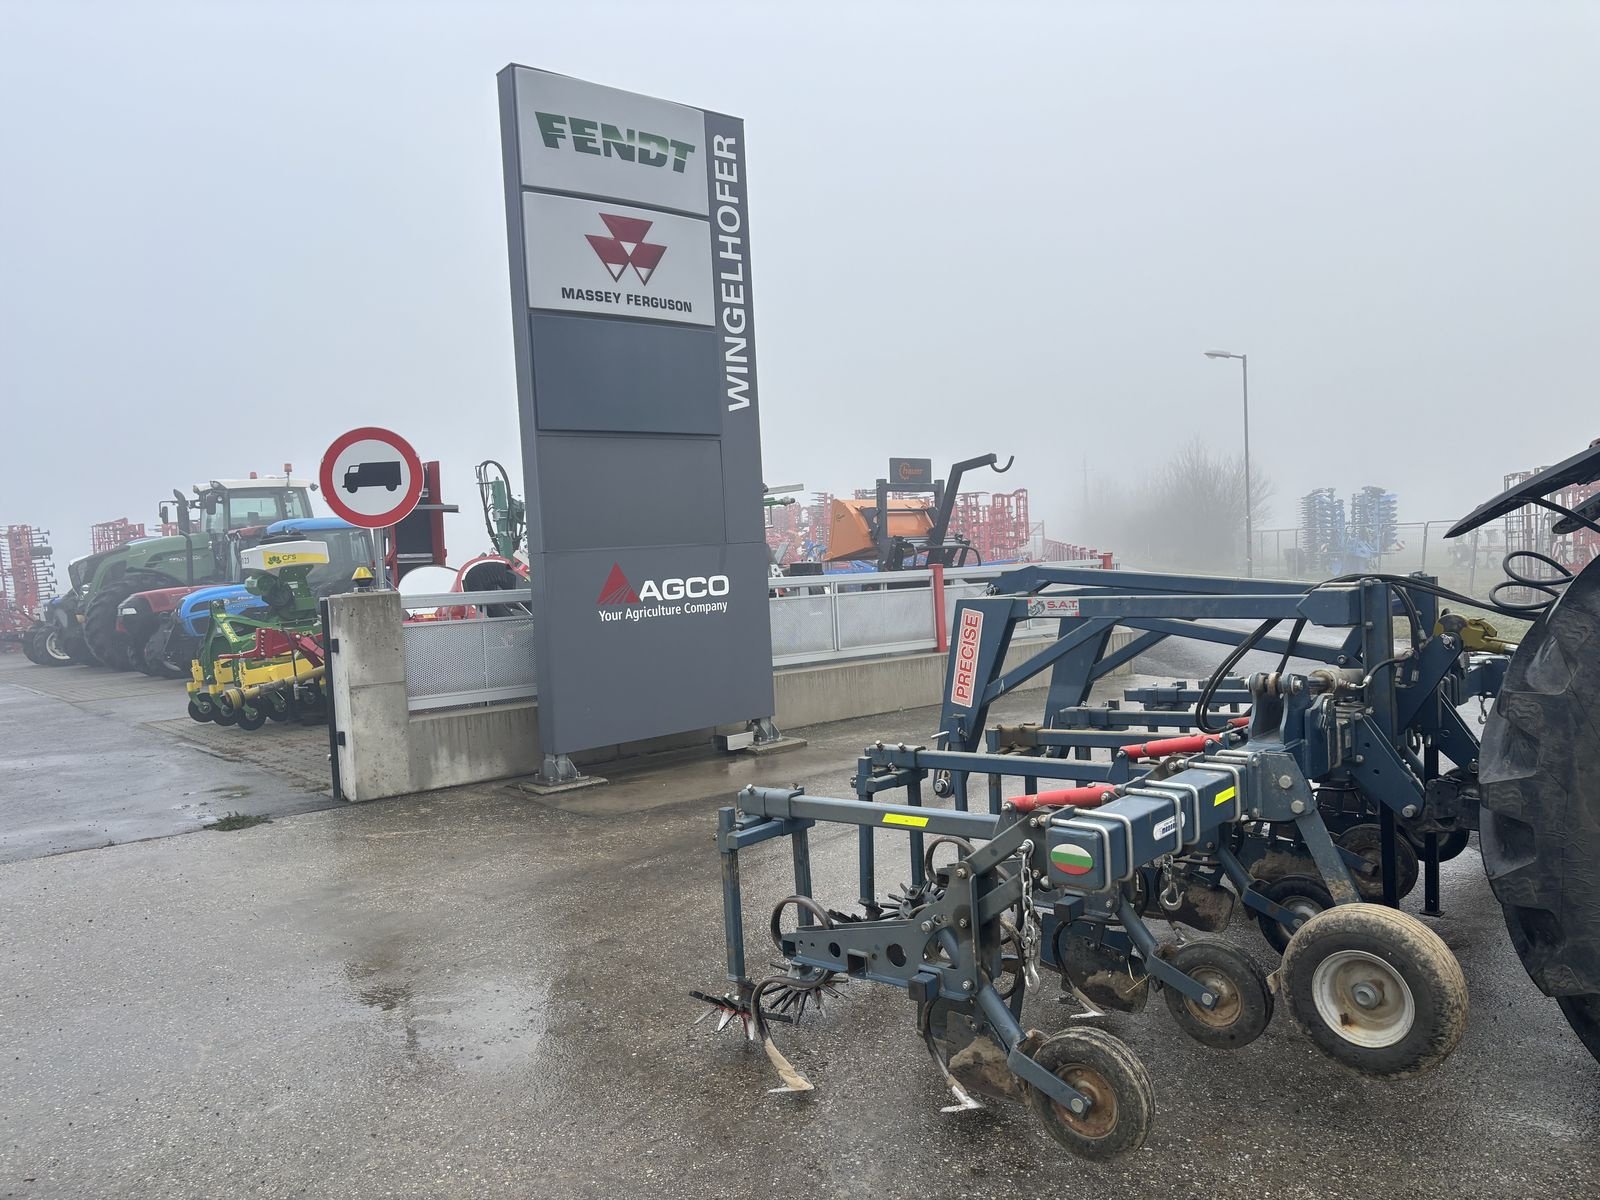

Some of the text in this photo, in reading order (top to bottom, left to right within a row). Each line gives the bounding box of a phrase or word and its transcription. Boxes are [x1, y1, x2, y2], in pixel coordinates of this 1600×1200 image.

[535, 111, 696, 174] FENDT
[713, 134, 751, 412] WINGELHOFER
[561, 286, 693, 313] MASSEY FERGUSON
[281, 553, 297, 561] CFS
[638, 575, 730, 602] AGCO
[599, 601, 728, 622] Your Agriculture Company
[956, 614, 979, 699] PRECISE
